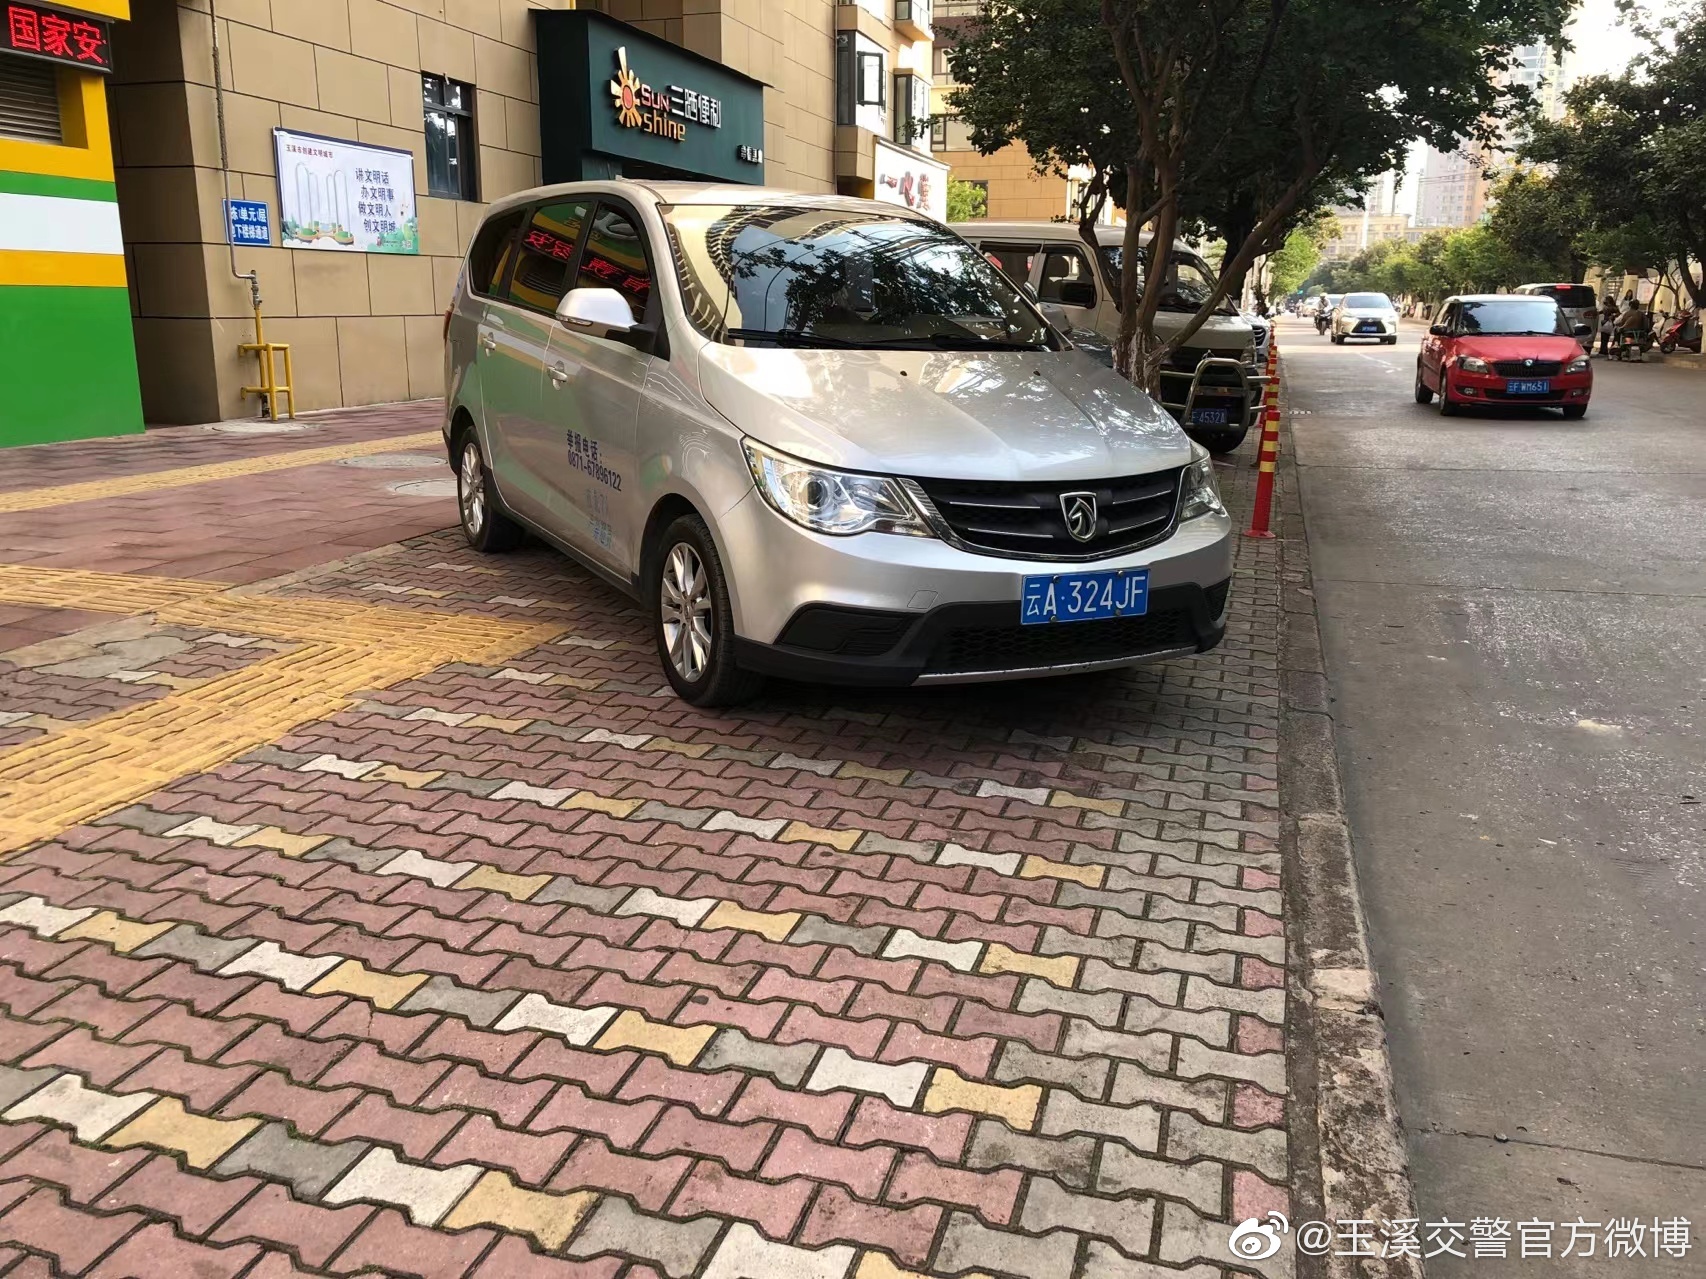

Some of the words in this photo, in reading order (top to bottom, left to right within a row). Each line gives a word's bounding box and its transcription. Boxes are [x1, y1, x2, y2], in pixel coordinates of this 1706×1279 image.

[8, 6, 103, 64] 国家安
[643, 110, 686, 141] shine
[286, 144, 333, 159] 玉溪市创建文明城市
[355, 168, 390, 185] 讲文明话
[360, 185, 395, 202] 办文明事
[357, 201, 392, 218] 做文明人
[363, 218, 396, 233] 创文明城
[568, 449, 622, 492] 0871-67896122
